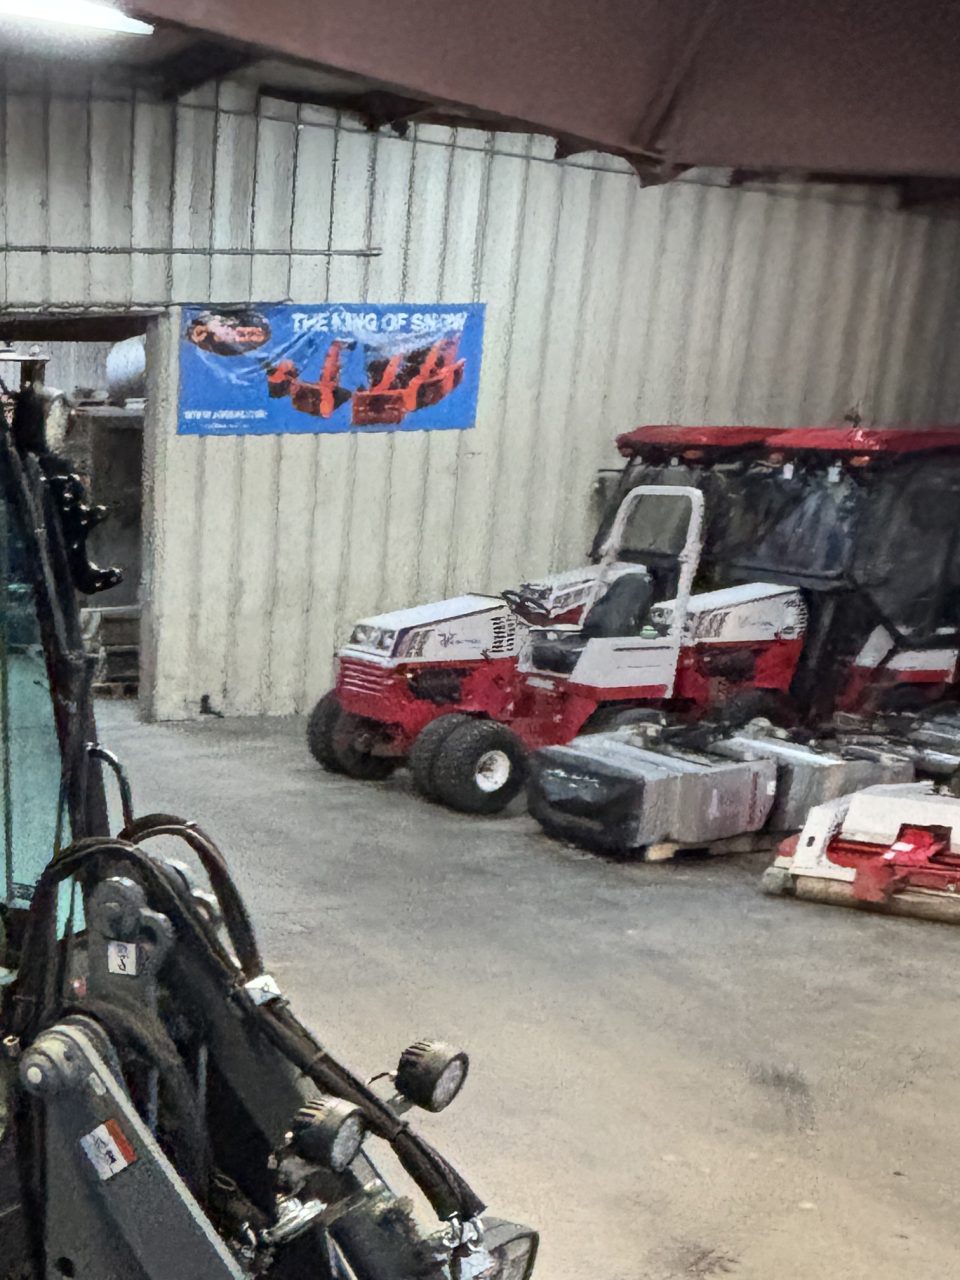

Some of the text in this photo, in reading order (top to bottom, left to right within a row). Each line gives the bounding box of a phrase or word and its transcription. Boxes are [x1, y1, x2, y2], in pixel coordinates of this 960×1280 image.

[292, 311, 468, 332] THE KING OF SNOW
